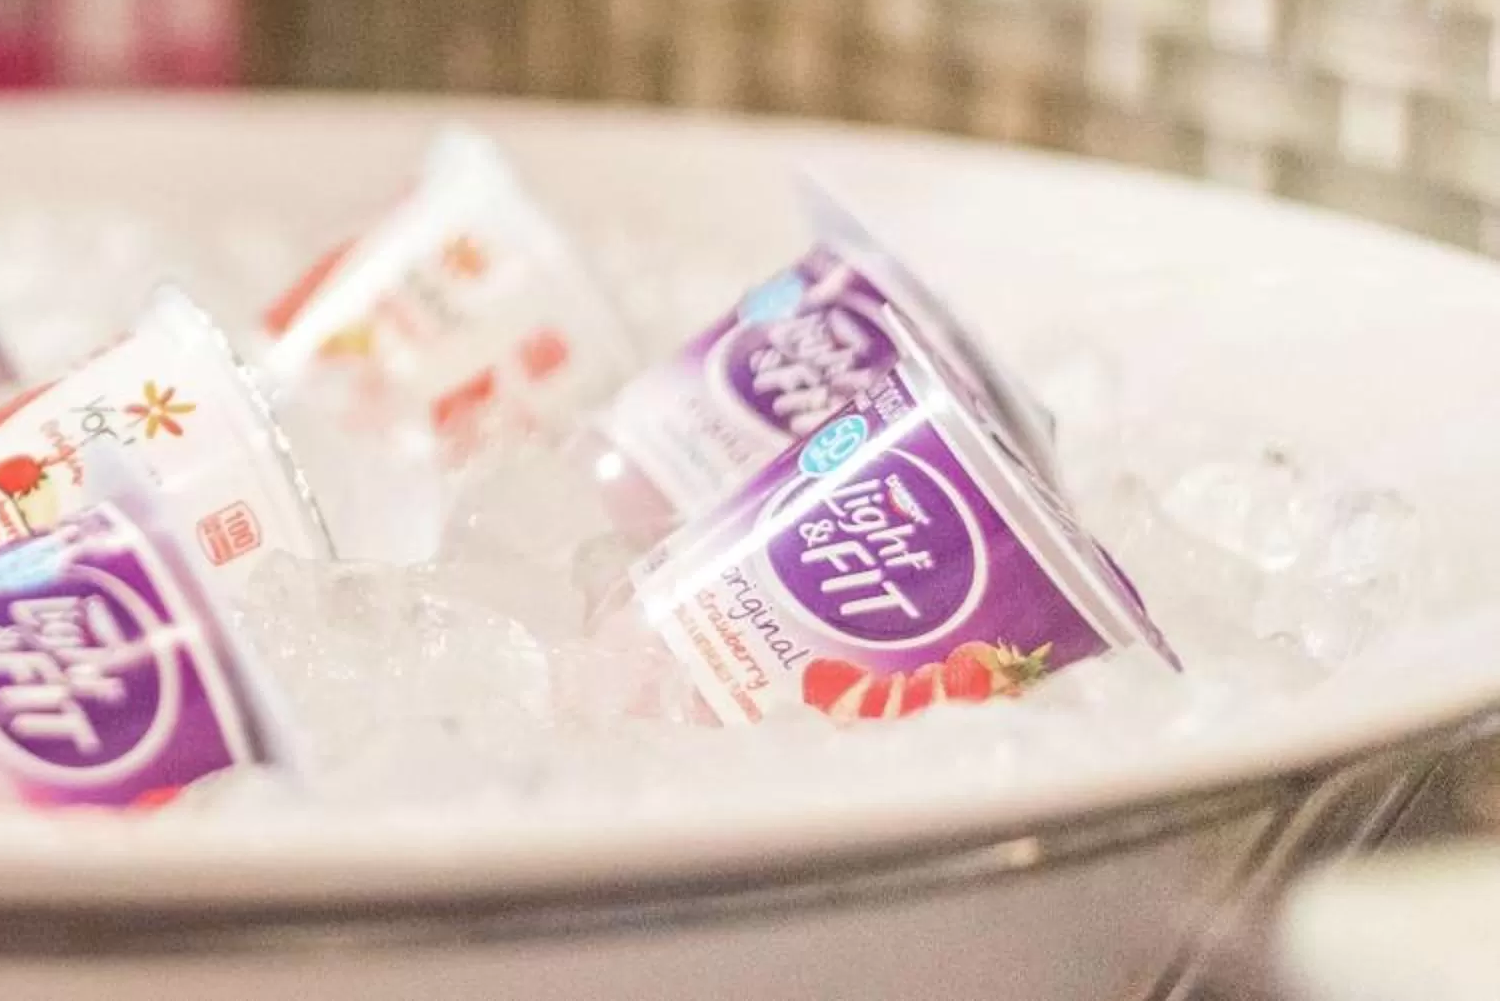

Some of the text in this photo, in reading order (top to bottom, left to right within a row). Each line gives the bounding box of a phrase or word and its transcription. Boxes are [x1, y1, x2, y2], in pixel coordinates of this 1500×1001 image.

[820, 420, 861, 458] 50
[224, 510, 256, 549] 100
[822, 477, 932, 568] Light
[800, 539, 921, 618] FIT
[696, 588, 771, 690] trawberry
